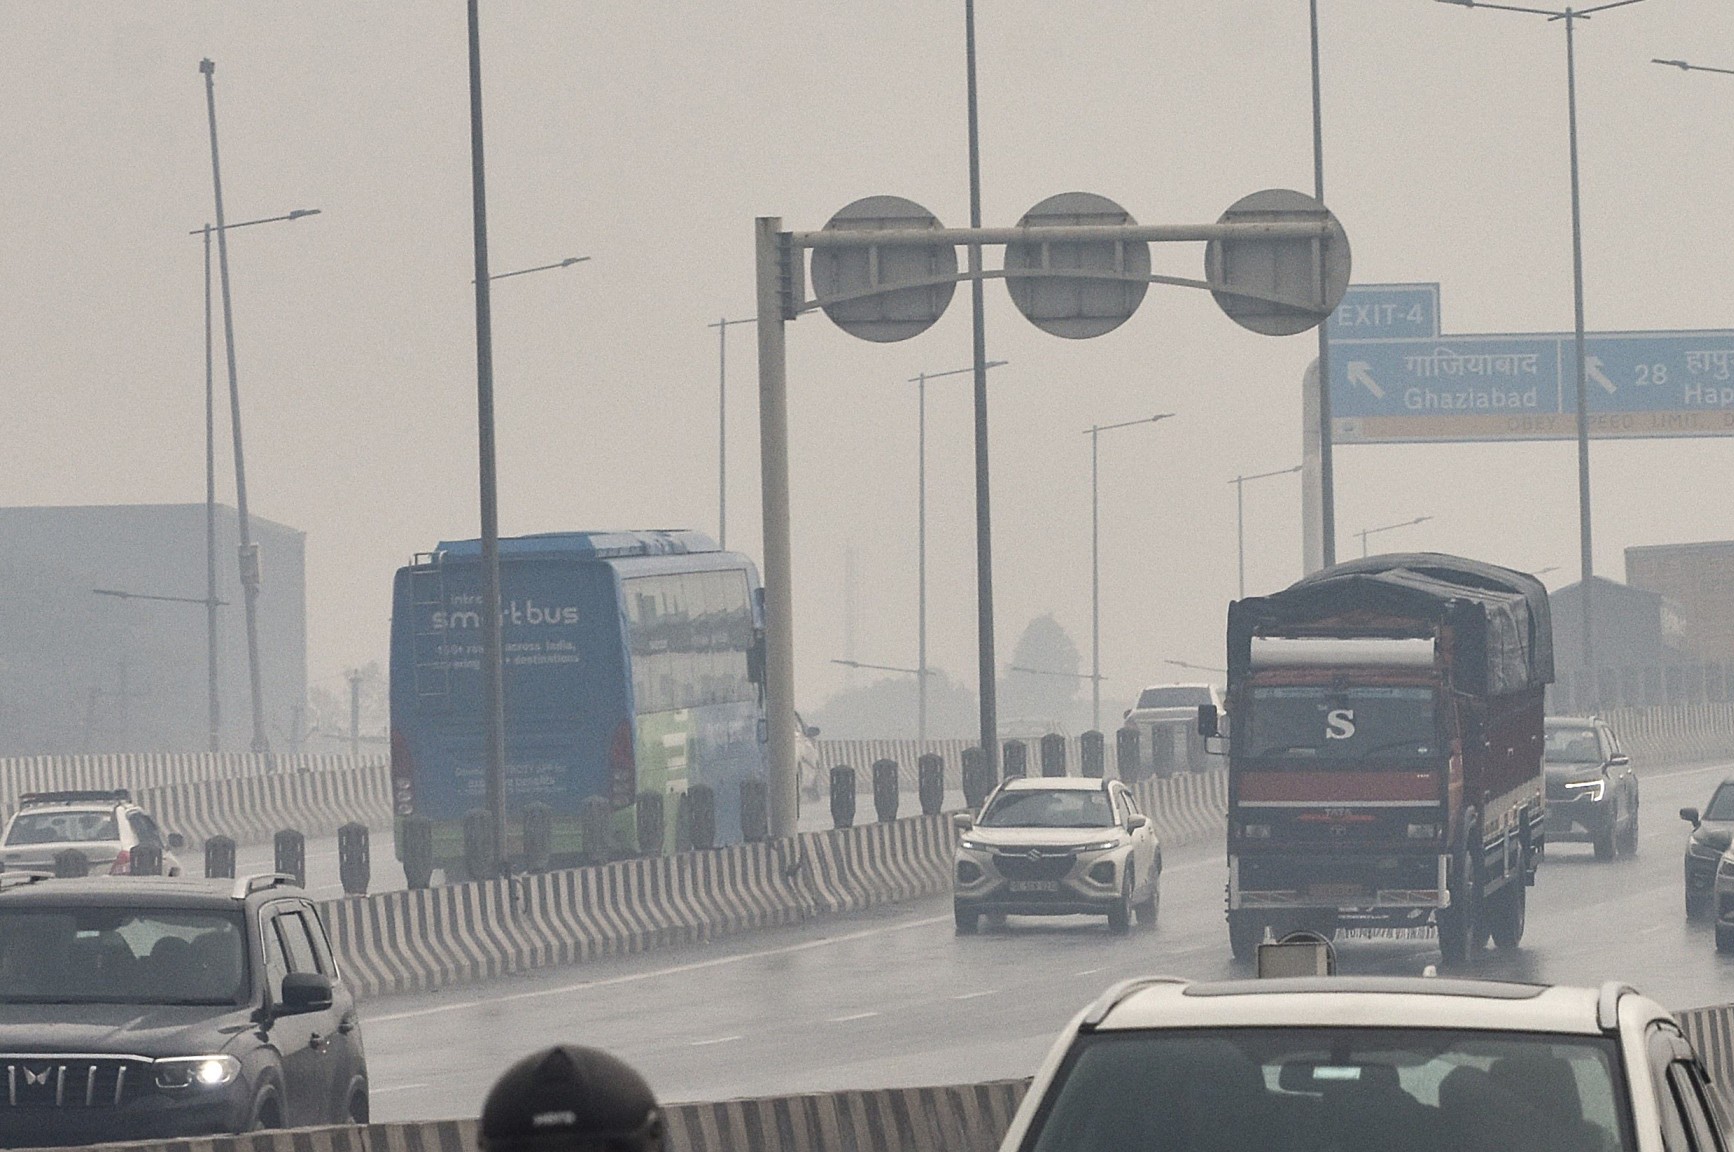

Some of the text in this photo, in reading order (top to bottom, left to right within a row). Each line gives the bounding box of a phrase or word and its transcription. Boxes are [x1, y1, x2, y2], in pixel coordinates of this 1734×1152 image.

[1337, 303, 1424, 327] EXIT-4
[1405, 346, 1538, 377] गाजियाबाद
[1634, 363, 1668, 386] 28
[1404, 384, 1538, 411] Ghaziabad
[1506, 415, 1557, 432] OBEY
[1575, 413, 1634, 430] PEED
[432, 599, 580, 629] smrtbus
[1325, 708, 1356, 740] S
[1325, 807, 1353, 818] TATA
